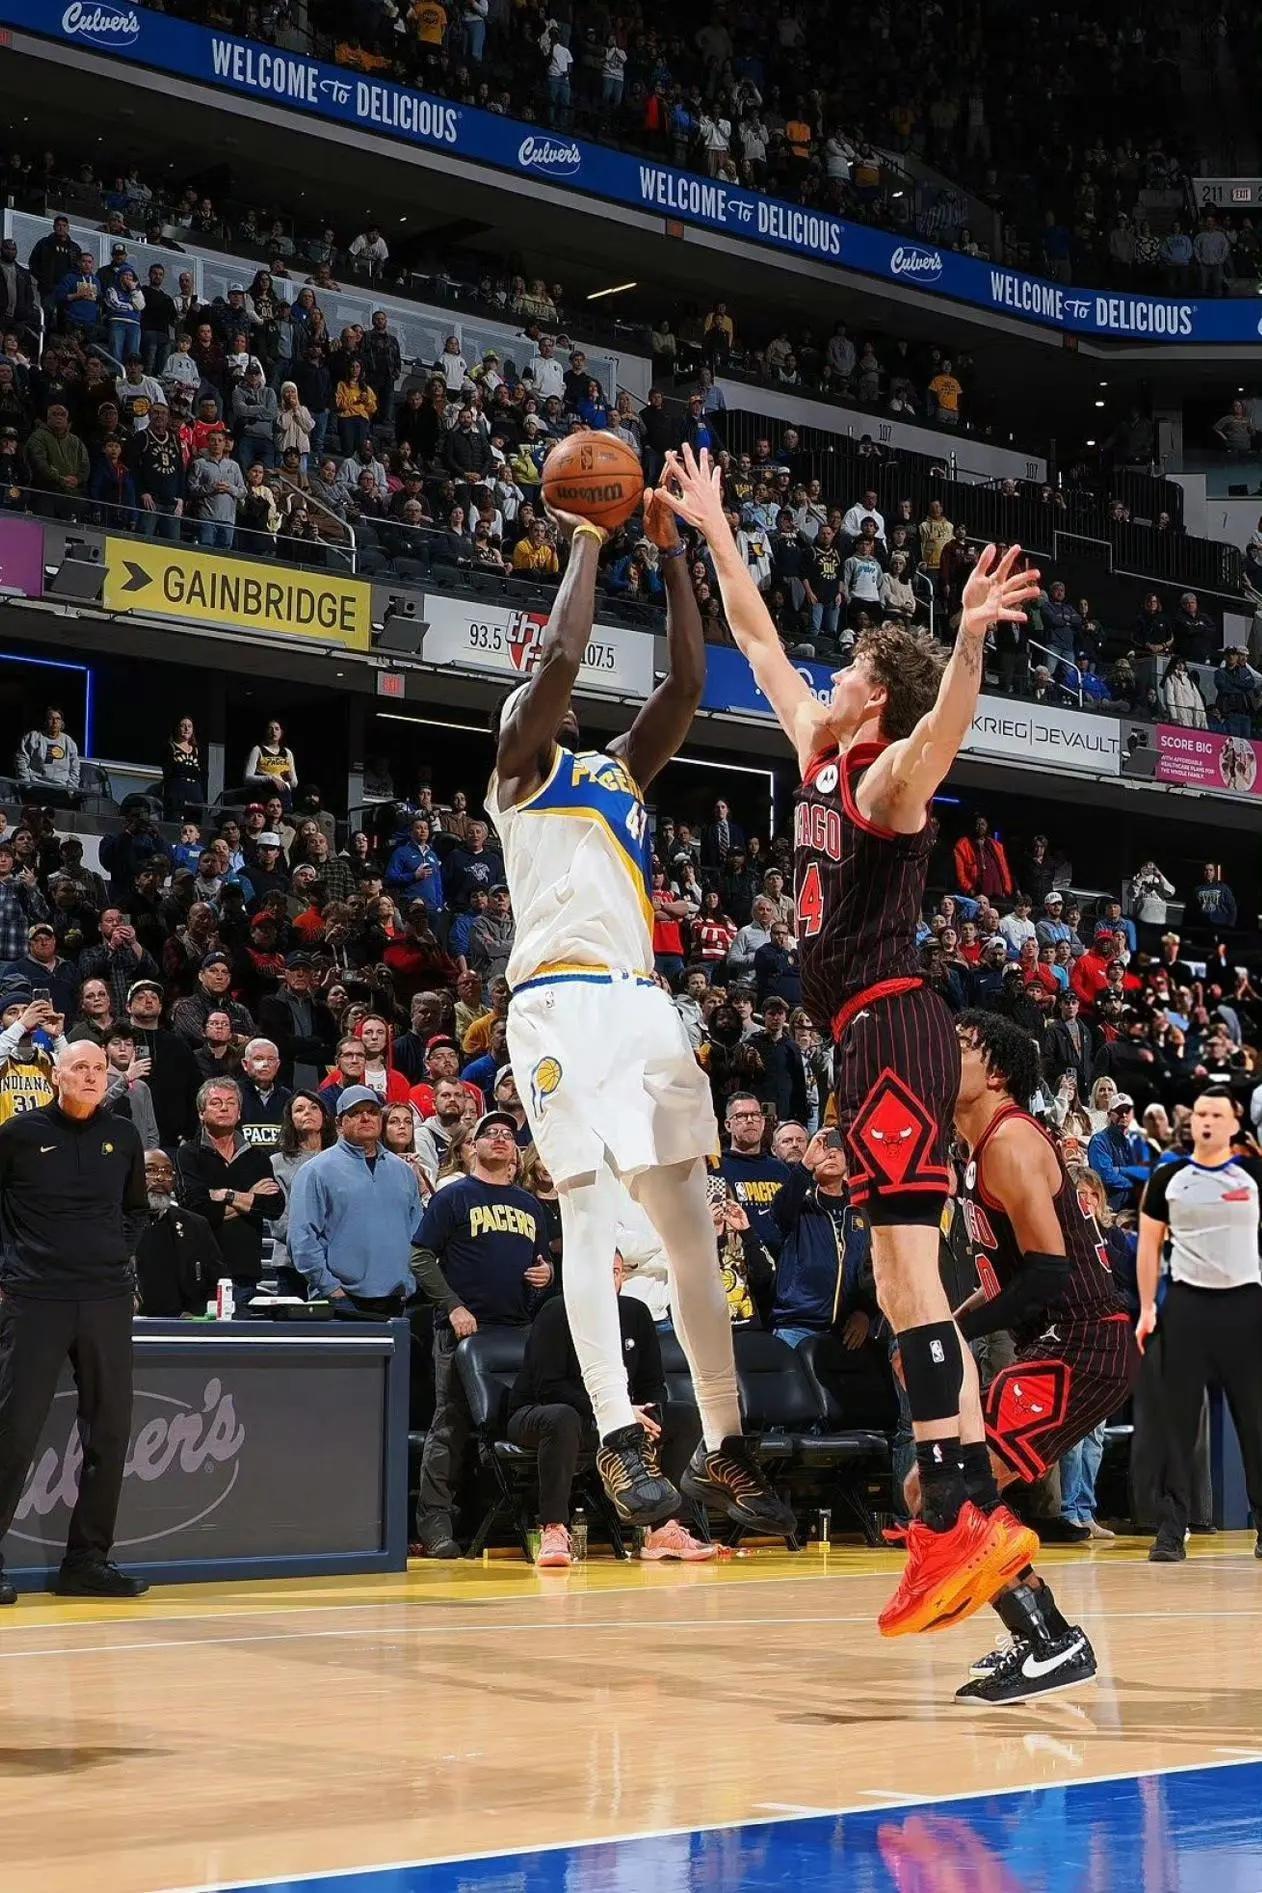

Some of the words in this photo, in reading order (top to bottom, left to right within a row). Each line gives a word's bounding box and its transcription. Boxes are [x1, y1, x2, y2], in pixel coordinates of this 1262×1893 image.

[62, 1, 140, 35] Culver's
[212, 38, 319, 101] WELCOME
[320, 79, 352, 104] to
[356, 84, 458, 143] DELICIOUS
[518, 136, 581, 166] Culver's
[1202, 186, 1222, 202] 211
[640, 165, 727, 221] WELCOME
[728, 200, 753, 222] to
[758, 201, 840, 255] DELICIOUS
[890, 246, 943, 275] Culver's
[991, 271, 1063, 320] WELCOME
[1064, 299, 1092, 320] to
[1096, 297, 1193, 335] DELICIOUS
[879, 423, 892, 442] 107
[1025, 462, 1039, 479] 107
[163, 565, 357, 632] GAINBRIDGE
[469, 623, 502, 650] 93.5
[972, 715, 1027, 738] KRIEG
[1035, 725, 1119, 754] DEVAULT
[1161, 735, 1194, 751] SCORE
[1196, 742, 1213, 754] BIG
[0, 1075, 52, 1094] NDIANA
[13, 1095, 37, 1113] 31
[242, 1127, 282, 1142] PACE
[469, 1203, 536, 1243] PACERS
